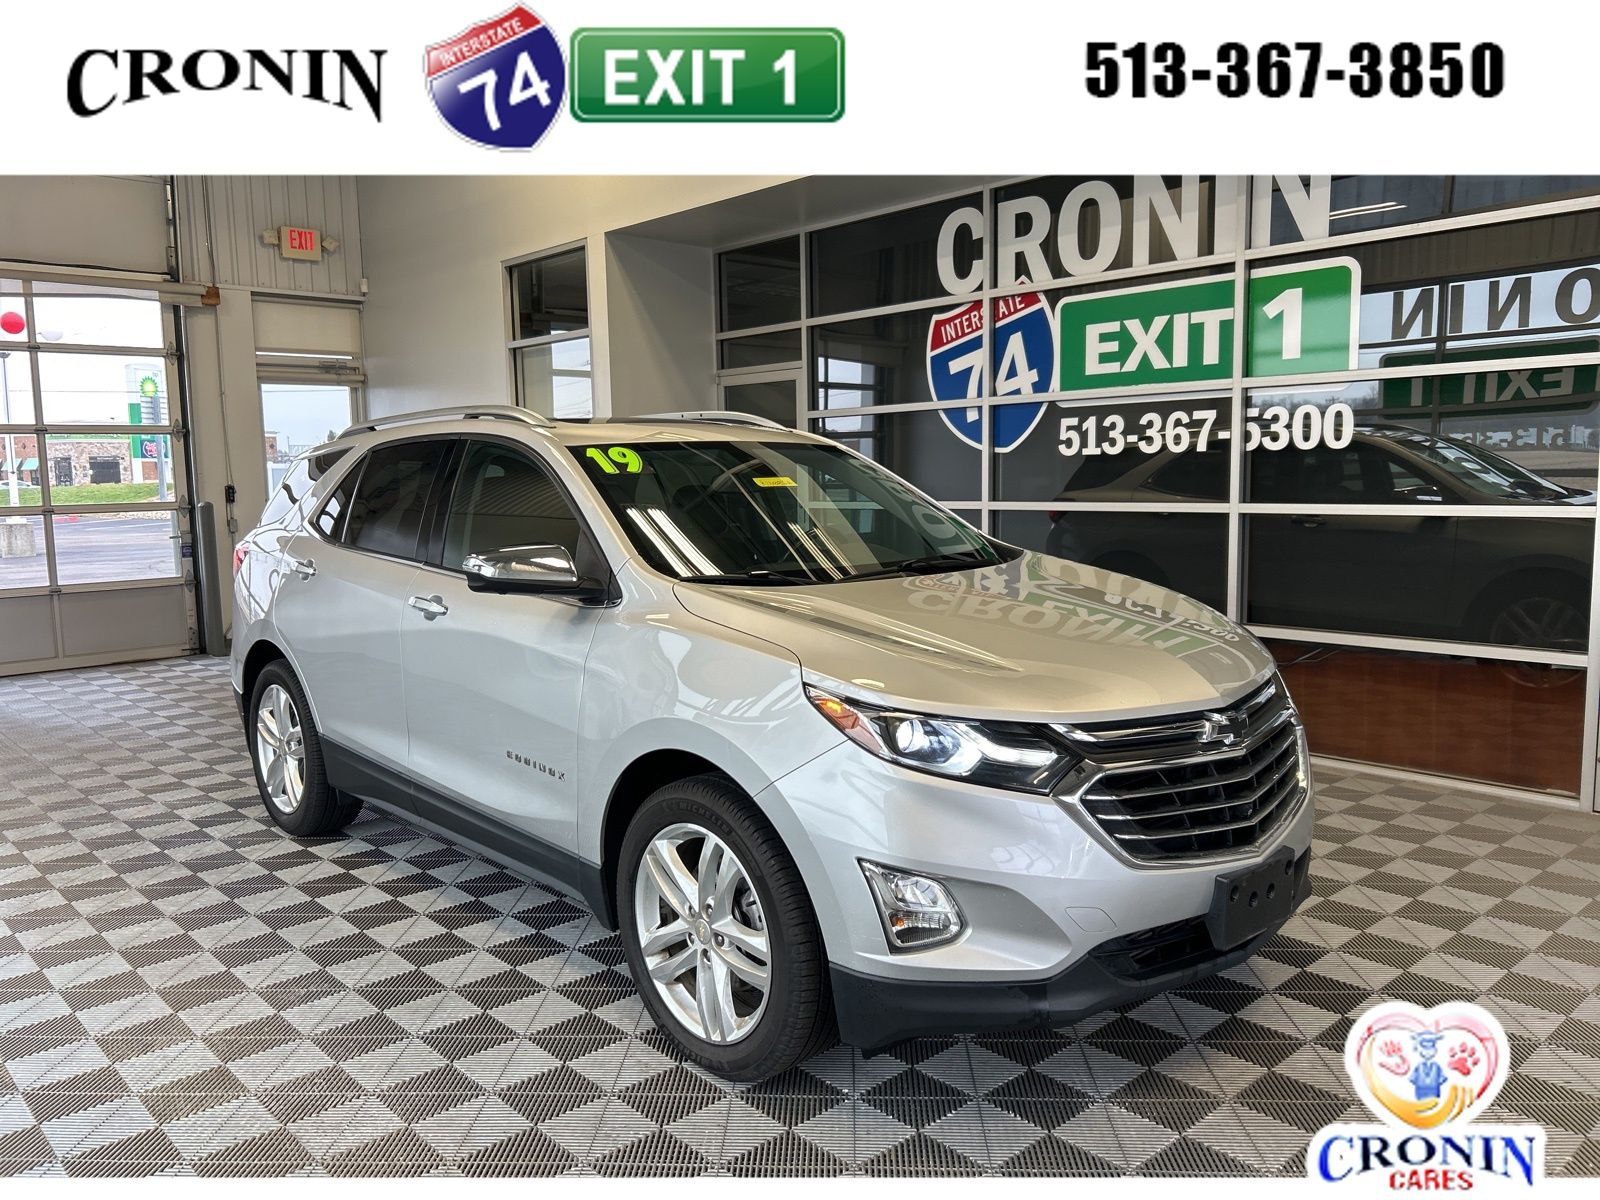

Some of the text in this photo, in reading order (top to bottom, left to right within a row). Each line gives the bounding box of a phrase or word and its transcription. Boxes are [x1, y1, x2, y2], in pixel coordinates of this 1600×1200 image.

[289, 229, 314, 251] EXIT
[1084, 287, 1303, 376] EXIT 1
[948, 331, 1039, 424] 74
[586, 446, 644, 475] 19
[506, 750, 566, 782] EQUINOX
